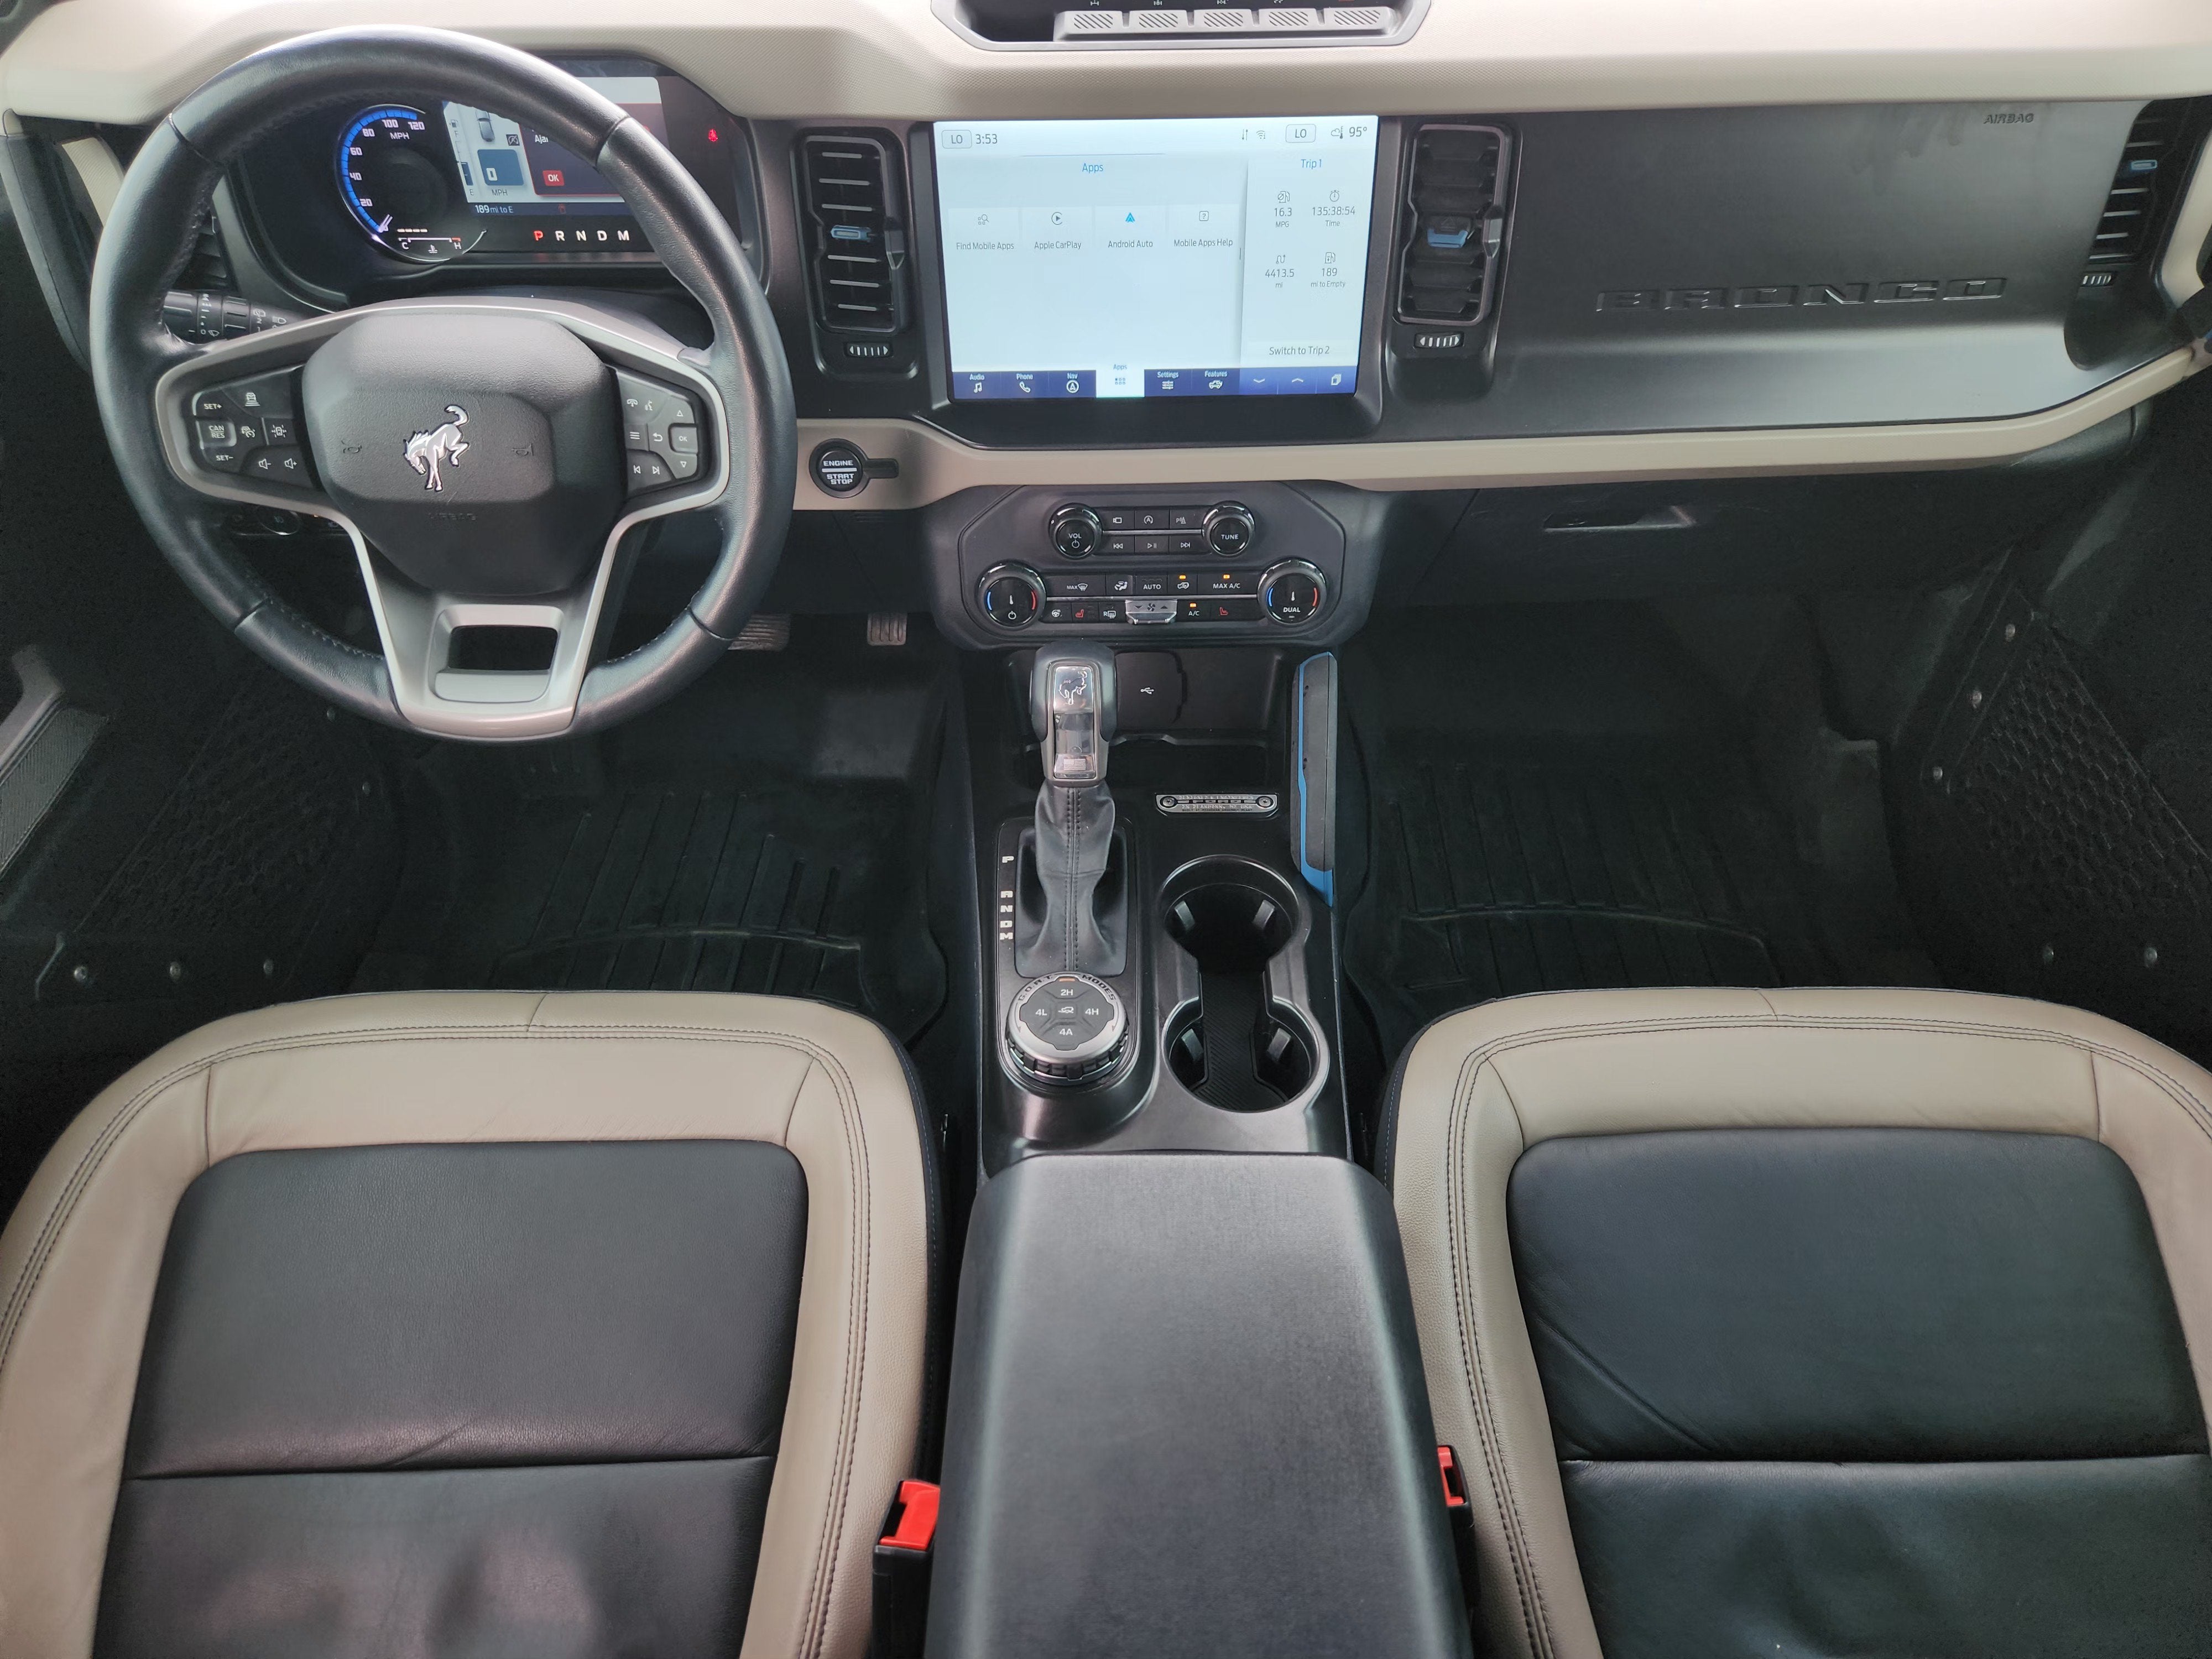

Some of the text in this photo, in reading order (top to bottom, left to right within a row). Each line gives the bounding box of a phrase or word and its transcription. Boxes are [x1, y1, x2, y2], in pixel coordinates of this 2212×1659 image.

[382, 119, 399, 128] 100
[1983, 113, 2035, 124] AIRBAG
[408, 121, 425, 130] 120
[362, 128, 375, 137] 80
[1295, 128, 1307, 138] LO
[951, 134, 963, 144] LO
[975, 134, 998, 144] 3:53
[349, 147, 363, 156] 60
[1082, 163, 1104, 174] Apps
[1301, 159, 1322, 169] Trip 1
[349, 172, 362, 181] 40
[486, 168, 498, 181] 0
[359, 199, 373, 207] 20
[1274, 207, 1292, 217] 16.3
[1312, 206, 1355, 216] 135:38:54
[533, 229, 630, 242] P R N D M
[973, 242, 995, 250] Mobile
[997, 242, 1014, 251] Apps
[1034, 241, 1082, 250] Apple CarPlay
[1136, 239, 1154, 248] Auto
[1198, 239, 1215, 248] Apps
[1217, 238, 1233, 247] Help
[1265, 268, 1295, 278] 4413.5
[1322, 268, 1338, 276] 189
[1595, 277, 2008, 312] BRONCO
[1269, 346, 1296, 356] Switch
[1308, 346, 1323, 356] Trip
[1324, 346, 1330, 354] 2
[1082, 974, 1117, 1000] MODES
